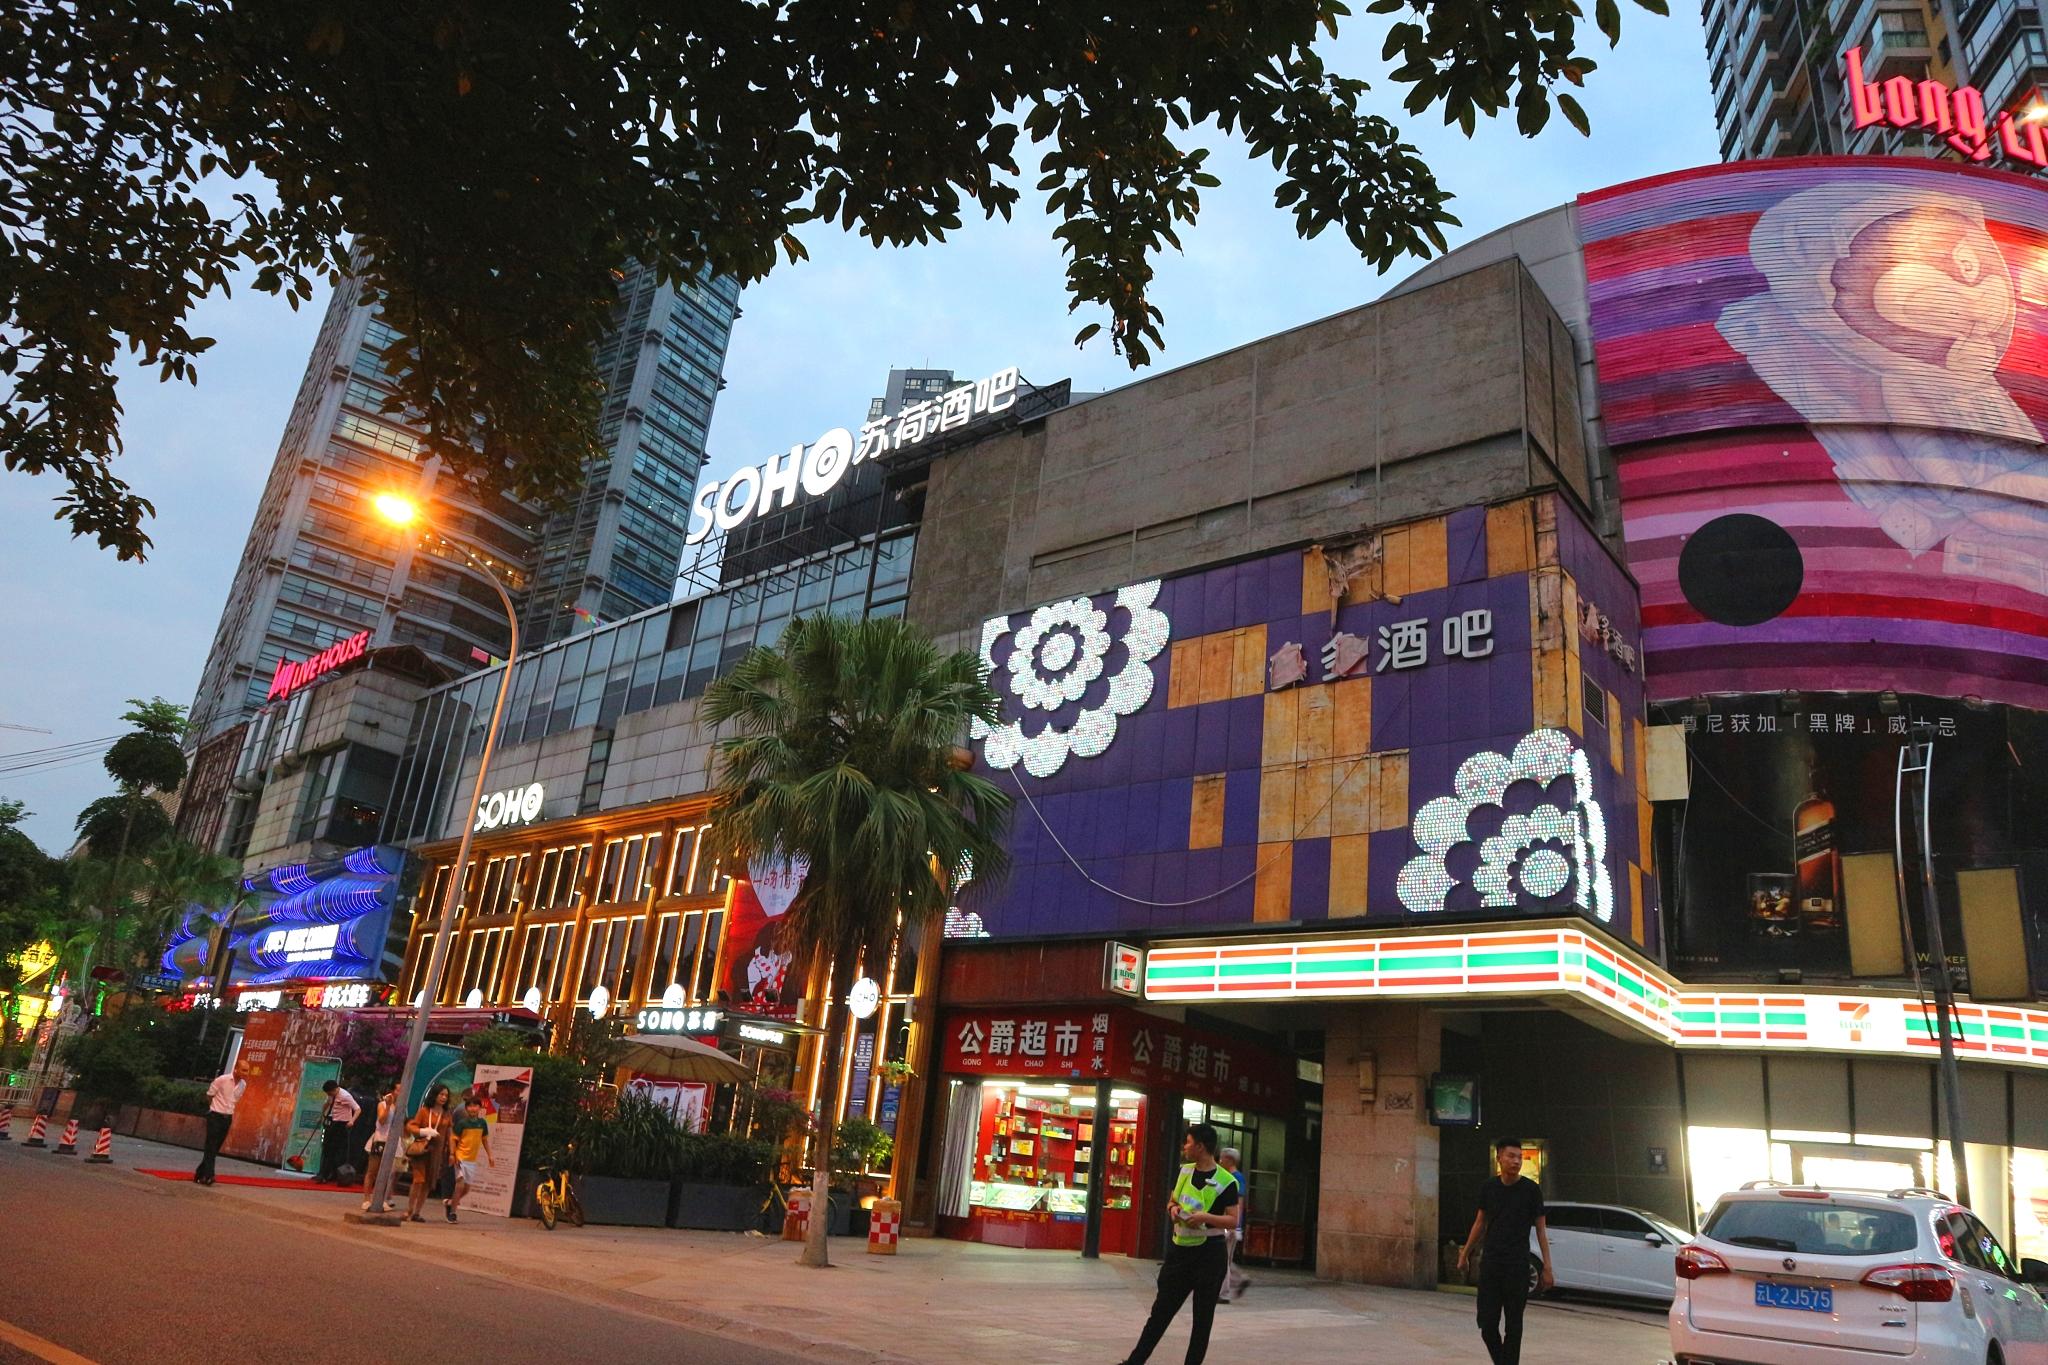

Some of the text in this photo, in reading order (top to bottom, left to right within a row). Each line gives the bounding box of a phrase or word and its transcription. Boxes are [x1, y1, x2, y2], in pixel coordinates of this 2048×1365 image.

[685, 366, 1021, 546] SOHO 苏荷酒吧
[473, 782, 544, 832] SOHO
[958, 1020, 1083, 1057] 公爵超市
[962, 1058, 1073, 1069] GONG JUE CHAO SHI
[1132, 1028, 1232, 1083] 公爵超市
